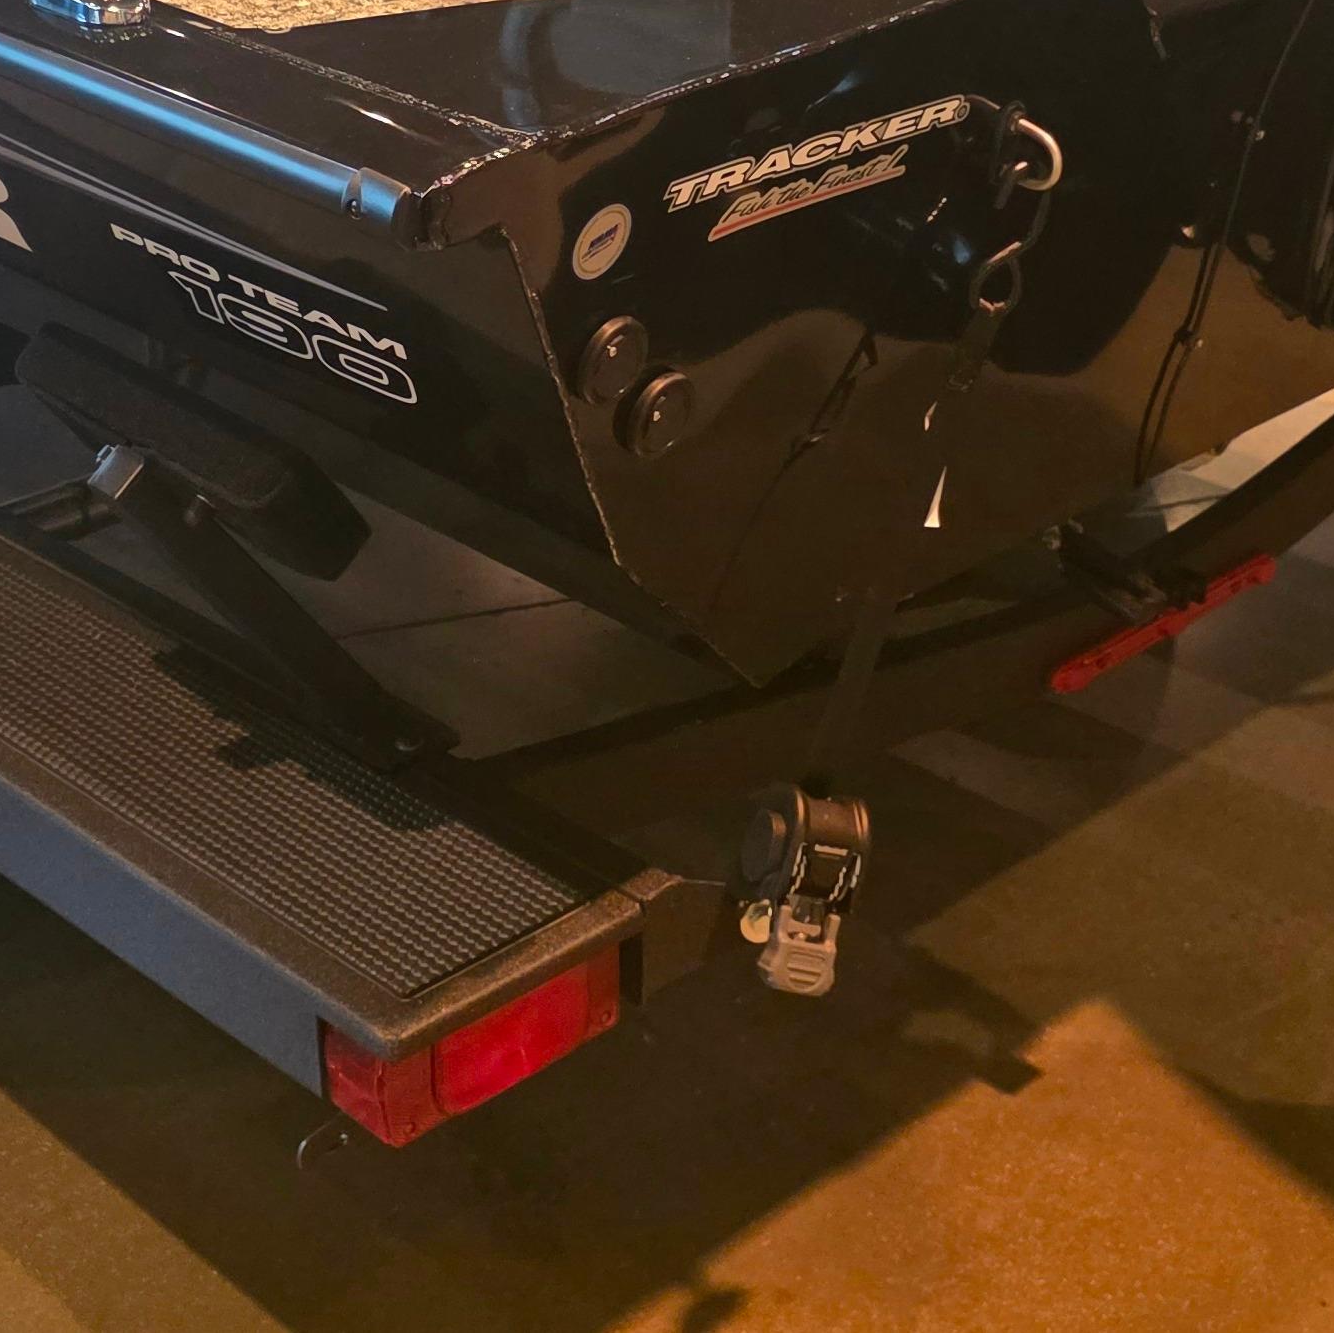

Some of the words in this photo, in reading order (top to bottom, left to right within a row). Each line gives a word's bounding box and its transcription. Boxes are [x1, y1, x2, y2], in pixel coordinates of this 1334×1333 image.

[666, 96, 965, 211] TRACKER
[721, 191, 774, 224] Fish
[775, 182, 810, 206] the
[109, 222, 221, 282] PRO
[227, 273, 409, 361] TEAM
[167, 270, 418, 405] 190
